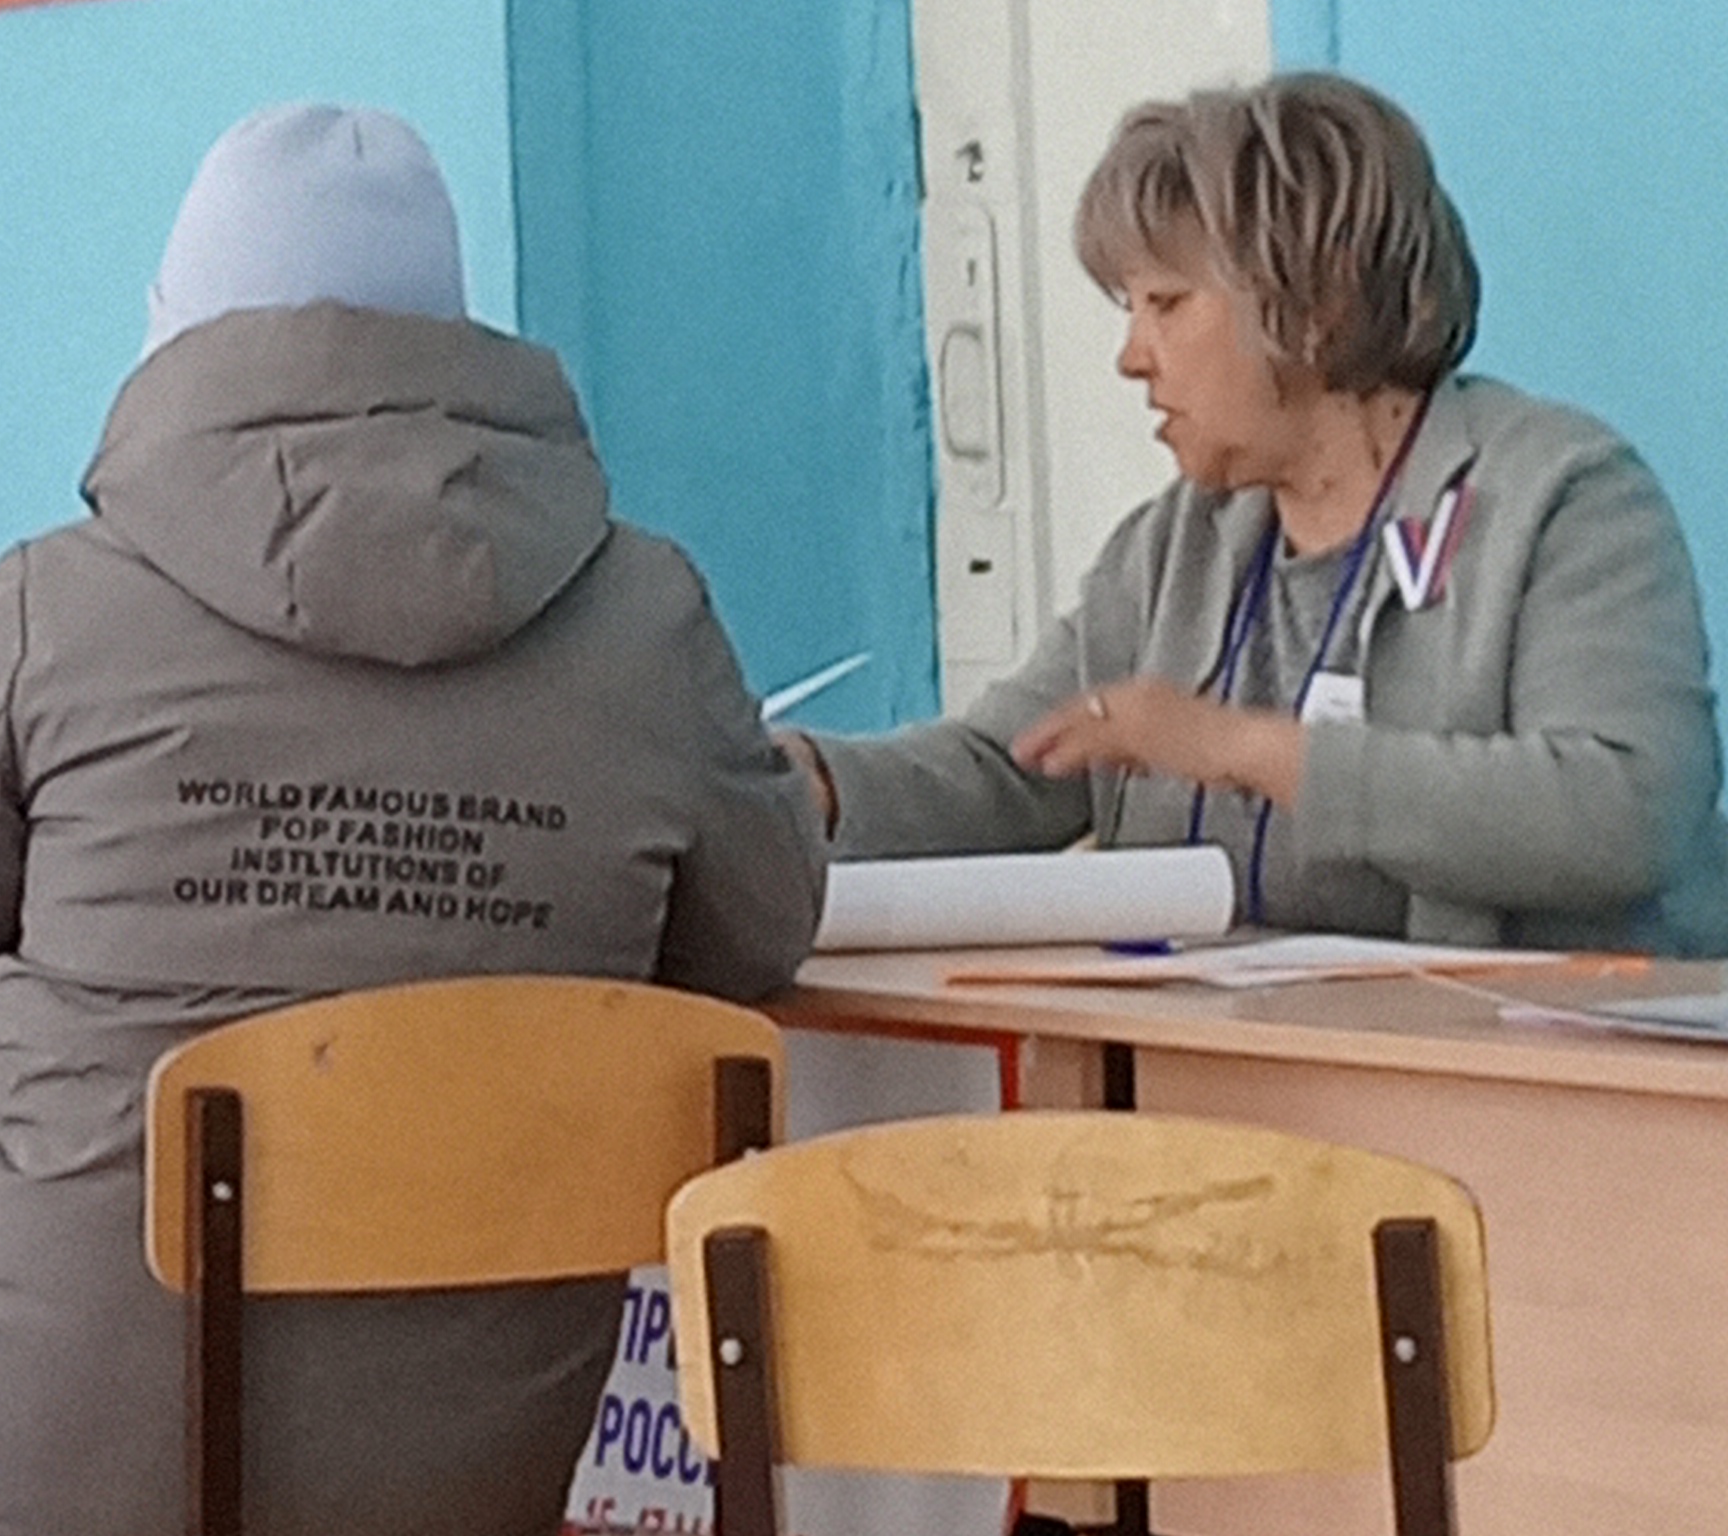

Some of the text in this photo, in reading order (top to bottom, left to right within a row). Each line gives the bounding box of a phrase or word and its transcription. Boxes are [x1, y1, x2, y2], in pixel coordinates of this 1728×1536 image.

[178, 778, 567, 831] WORLD FAMOUS BRAND
[260, 815, 484, 856] POP FASHION
[465, 860, 507, 891] OF
[174, 876, 556, 930] OUR DREAM AND HOPE
